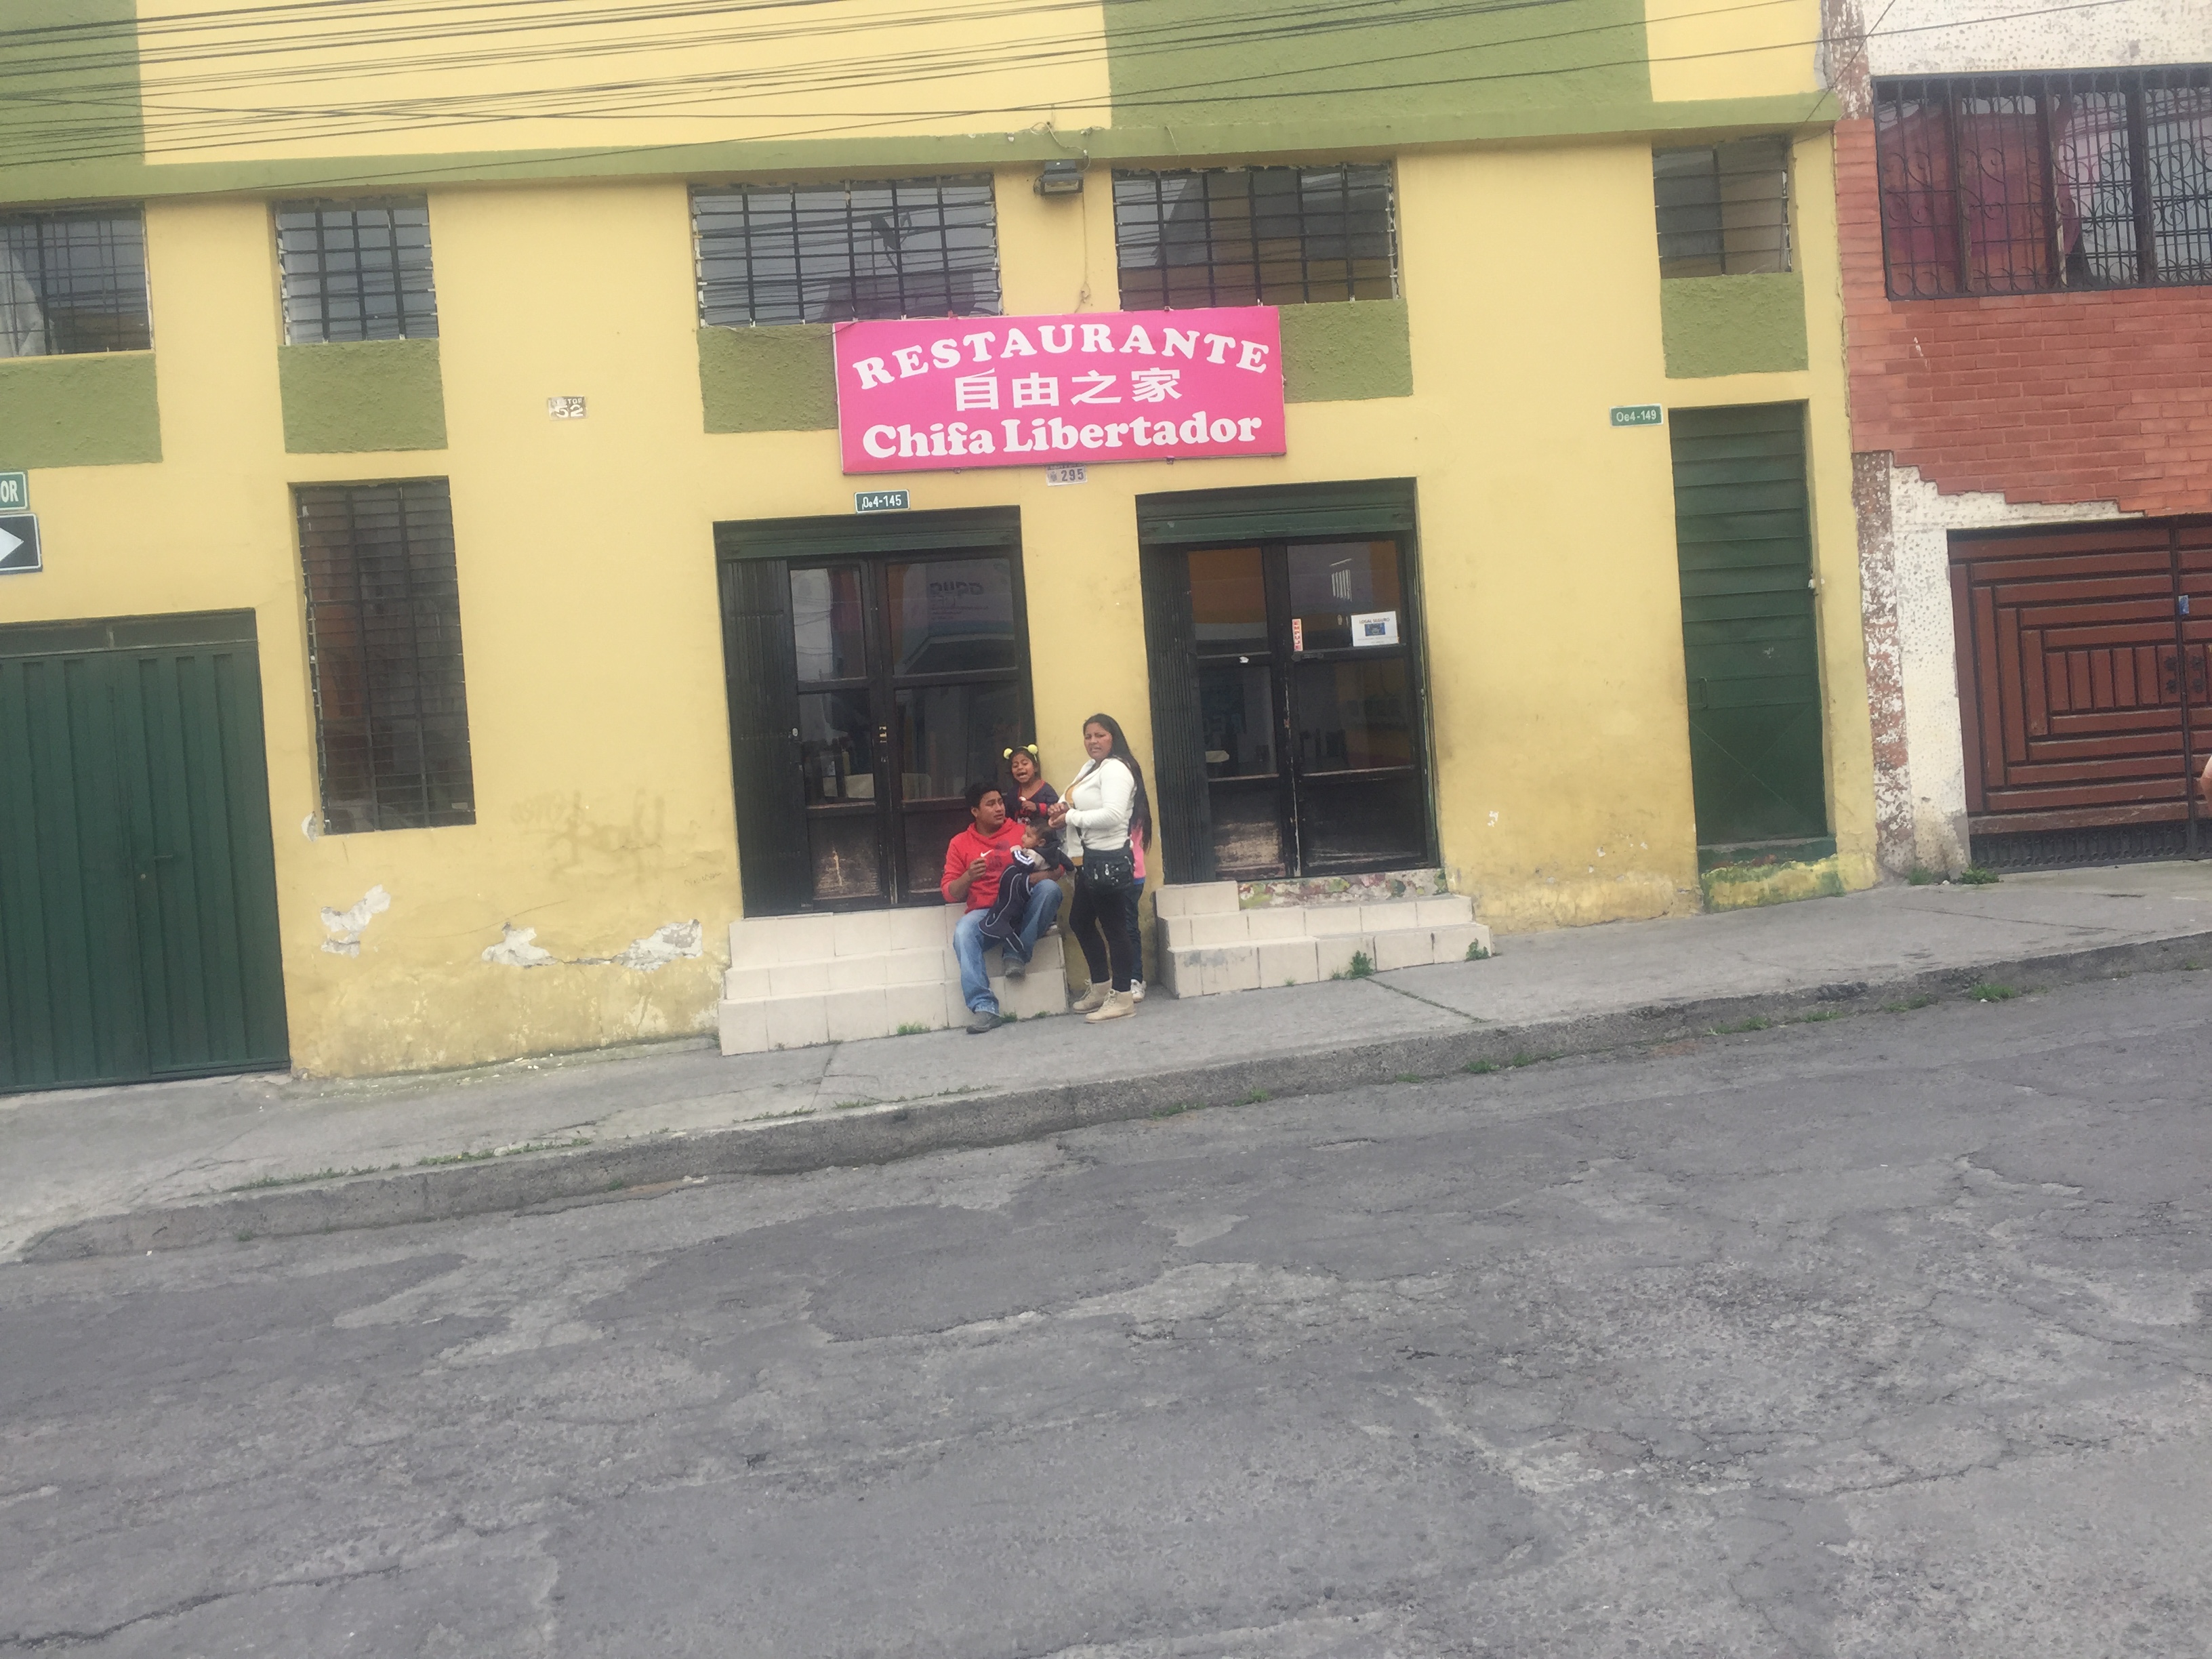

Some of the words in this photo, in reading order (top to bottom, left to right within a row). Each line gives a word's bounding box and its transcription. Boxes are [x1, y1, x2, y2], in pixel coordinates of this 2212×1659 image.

[853, 324, 1269, 390] RESTAURANTE
[954, 367, 1183, 411] 自由之家
[554, 404, 583, 418] 52
[1616, 409, 1657, 422] Oe4-149
[863, 422, 996, 459] Chifa
[1001, 411, 1262, 453] Libertador
[1061, 468, 1084, 482] 295
